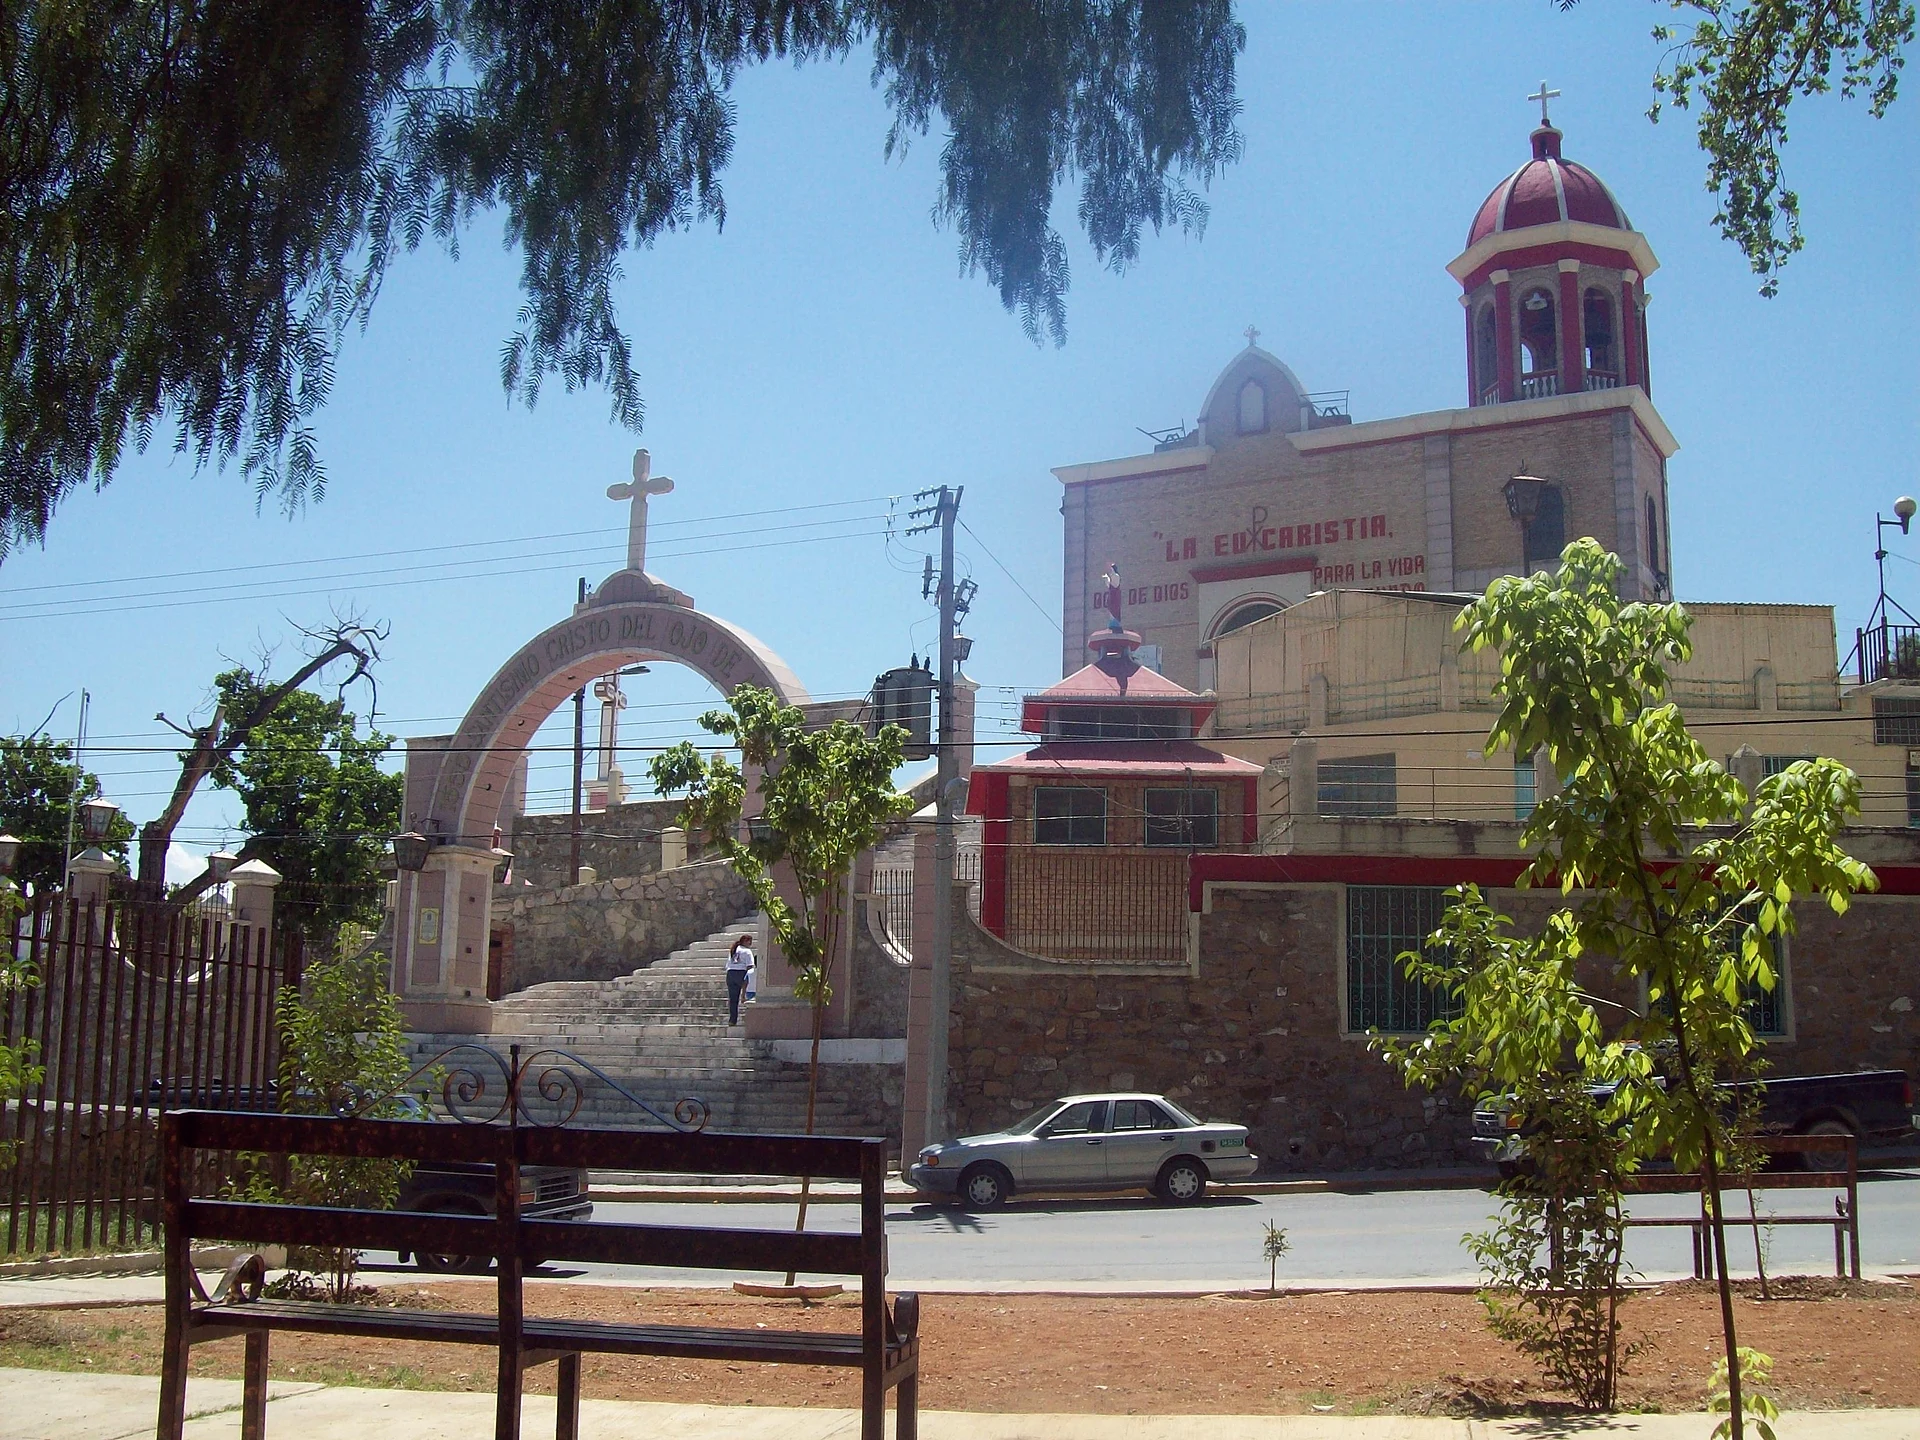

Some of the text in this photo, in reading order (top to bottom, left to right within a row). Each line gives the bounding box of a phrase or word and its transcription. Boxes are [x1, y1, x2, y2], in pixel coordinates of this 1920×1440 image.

[1127, 586, 1148, 606] DE
[1152, 581, 1189, 603] DIOS
[1313, 563, 1355, 585] PARA
[1361, 560, 1382, 580] LA
[1388, 554, 1425, 577] VIDA
[545, 617, 611, 662] CRISTO
[621, 614, 657, 641] DEL
[669, 620, 707, 655] OJO
[711, 643, 744, 679] DE
